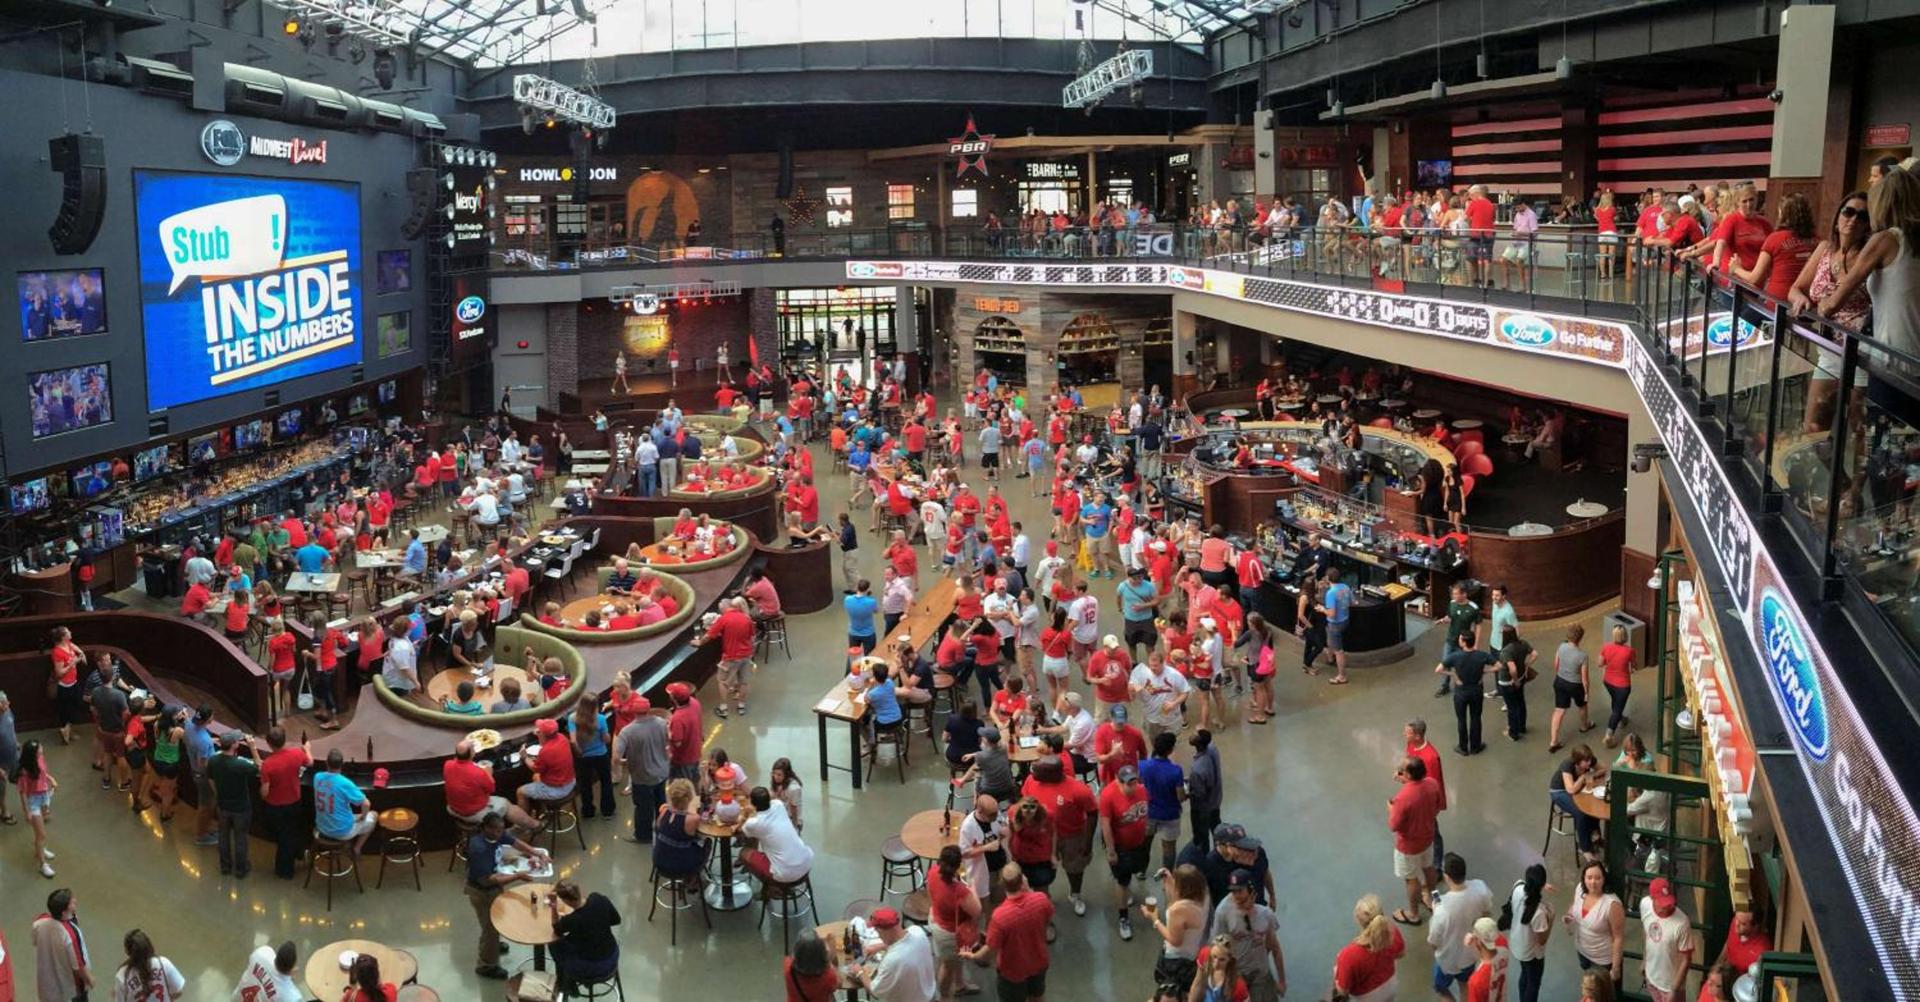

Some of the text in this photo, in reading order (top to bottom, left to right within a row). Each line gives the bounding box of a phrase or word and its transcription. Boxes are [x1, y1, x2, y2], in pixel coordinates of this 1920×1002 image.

[250, 136, 292, 158] MIDWEST
[950, 141, 986, 153] PBR
[1032, 163, 1057, 177] BARN
[1169, 153, 1189, 166] PBR
[520, 168, 561, 181] HOWL
[455, 192, 477, 214] Mercy
[172, 225, 230, 264] Stub
[202, 261, 352, 343] INSIDE
[207, 310, 354, 372] THE NUMBERS
[1560, 331, 1577, 345] Go
[1577, 332, 1615, 352] Further
[1769, 608, 1810, 729] Ford
[1834, 750, 1862, 832] Go
[316, 791, 335, 815] 51
